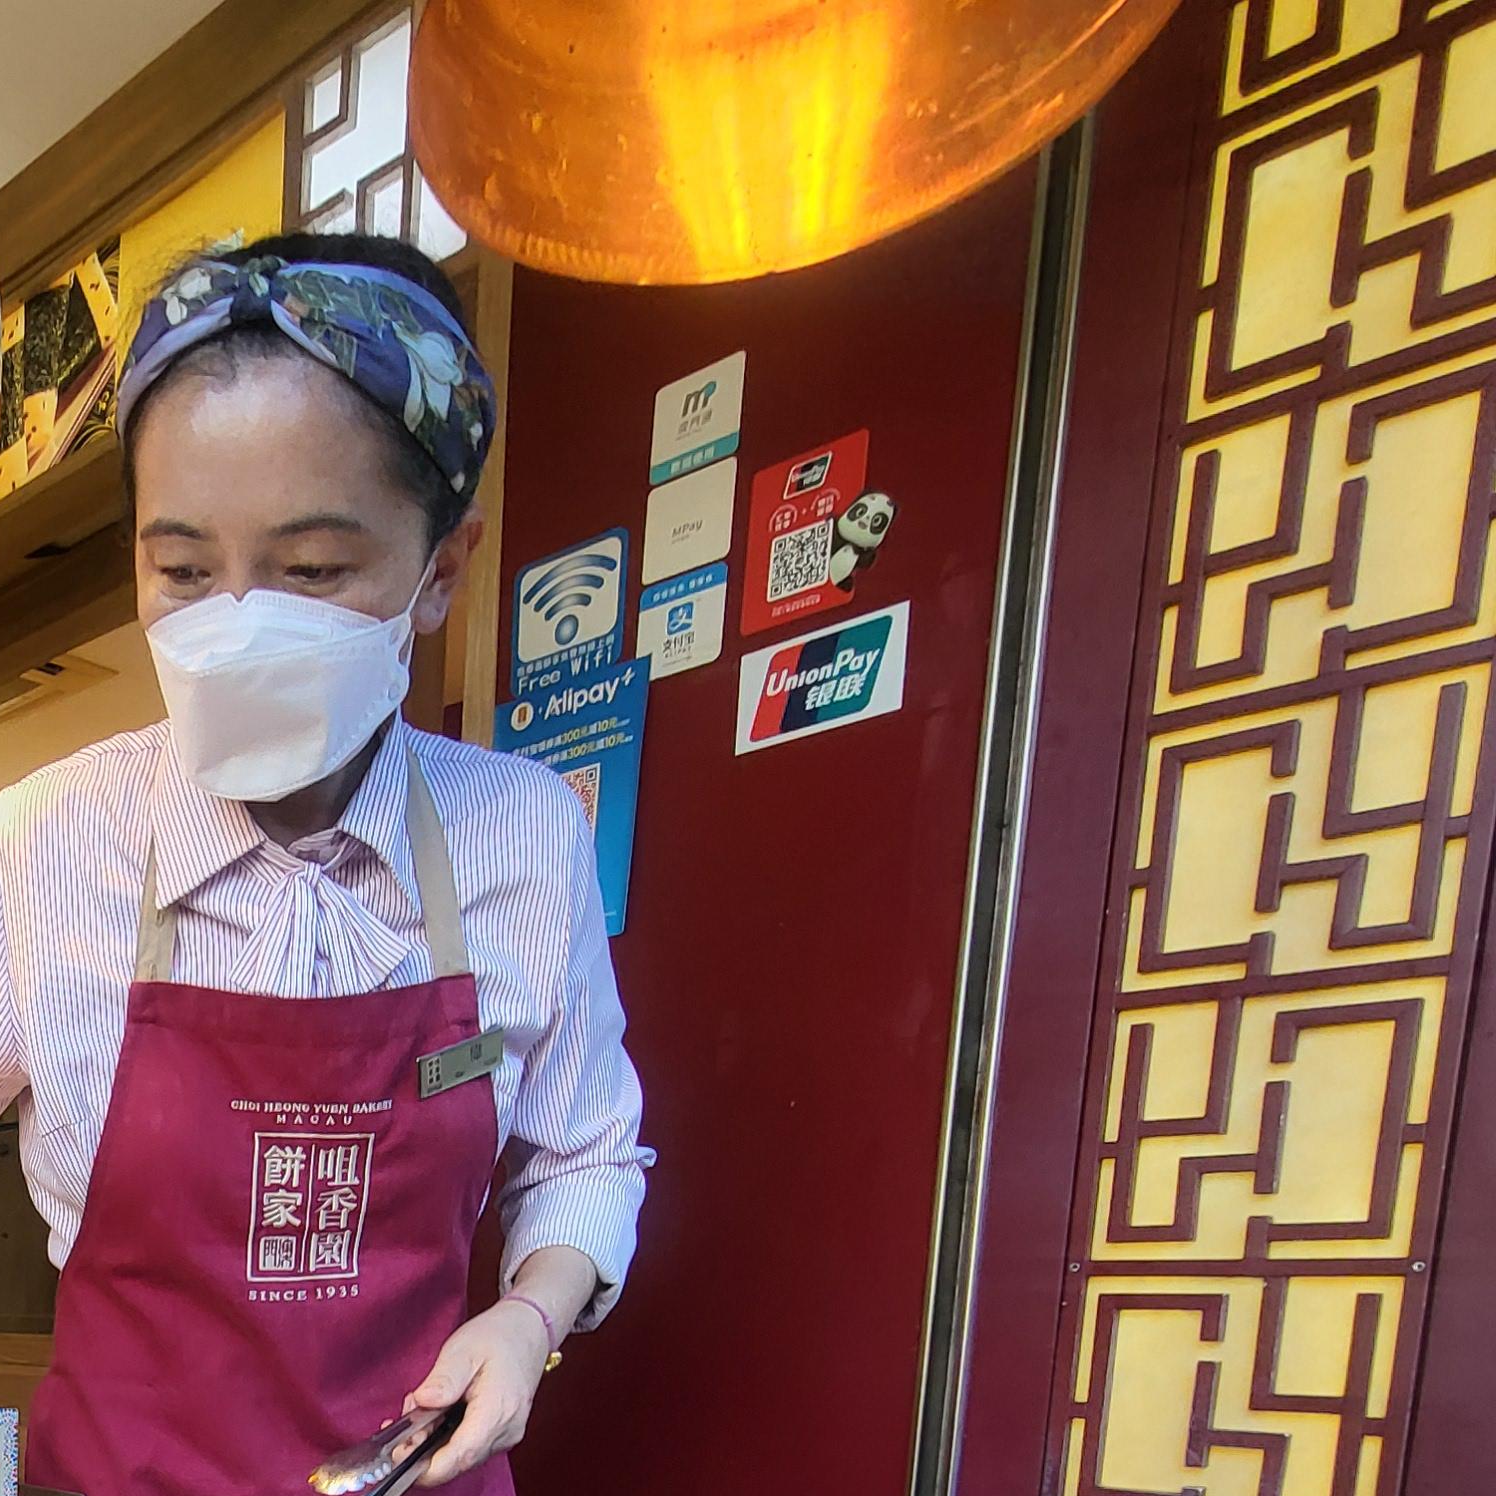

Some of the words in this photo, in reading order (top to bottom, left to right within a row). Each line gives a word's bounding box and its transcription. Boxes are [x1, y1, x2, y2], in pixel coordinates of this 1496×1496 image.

[671, 519, 703, 537] MPay
[518, 670, 561, 696] Free
[766, 648, 881, 697] UnionPay
[805, 673, 866, 711] 银联
[276, 1113, 353, 1126] MACAU
[261, 1143, 307, 1229] 餅家
[309, 1143, 361, 1273] 咀香園
[248, 1289, 308, 1302] SINCE
[315, 1284, 360, 1300] 1935
